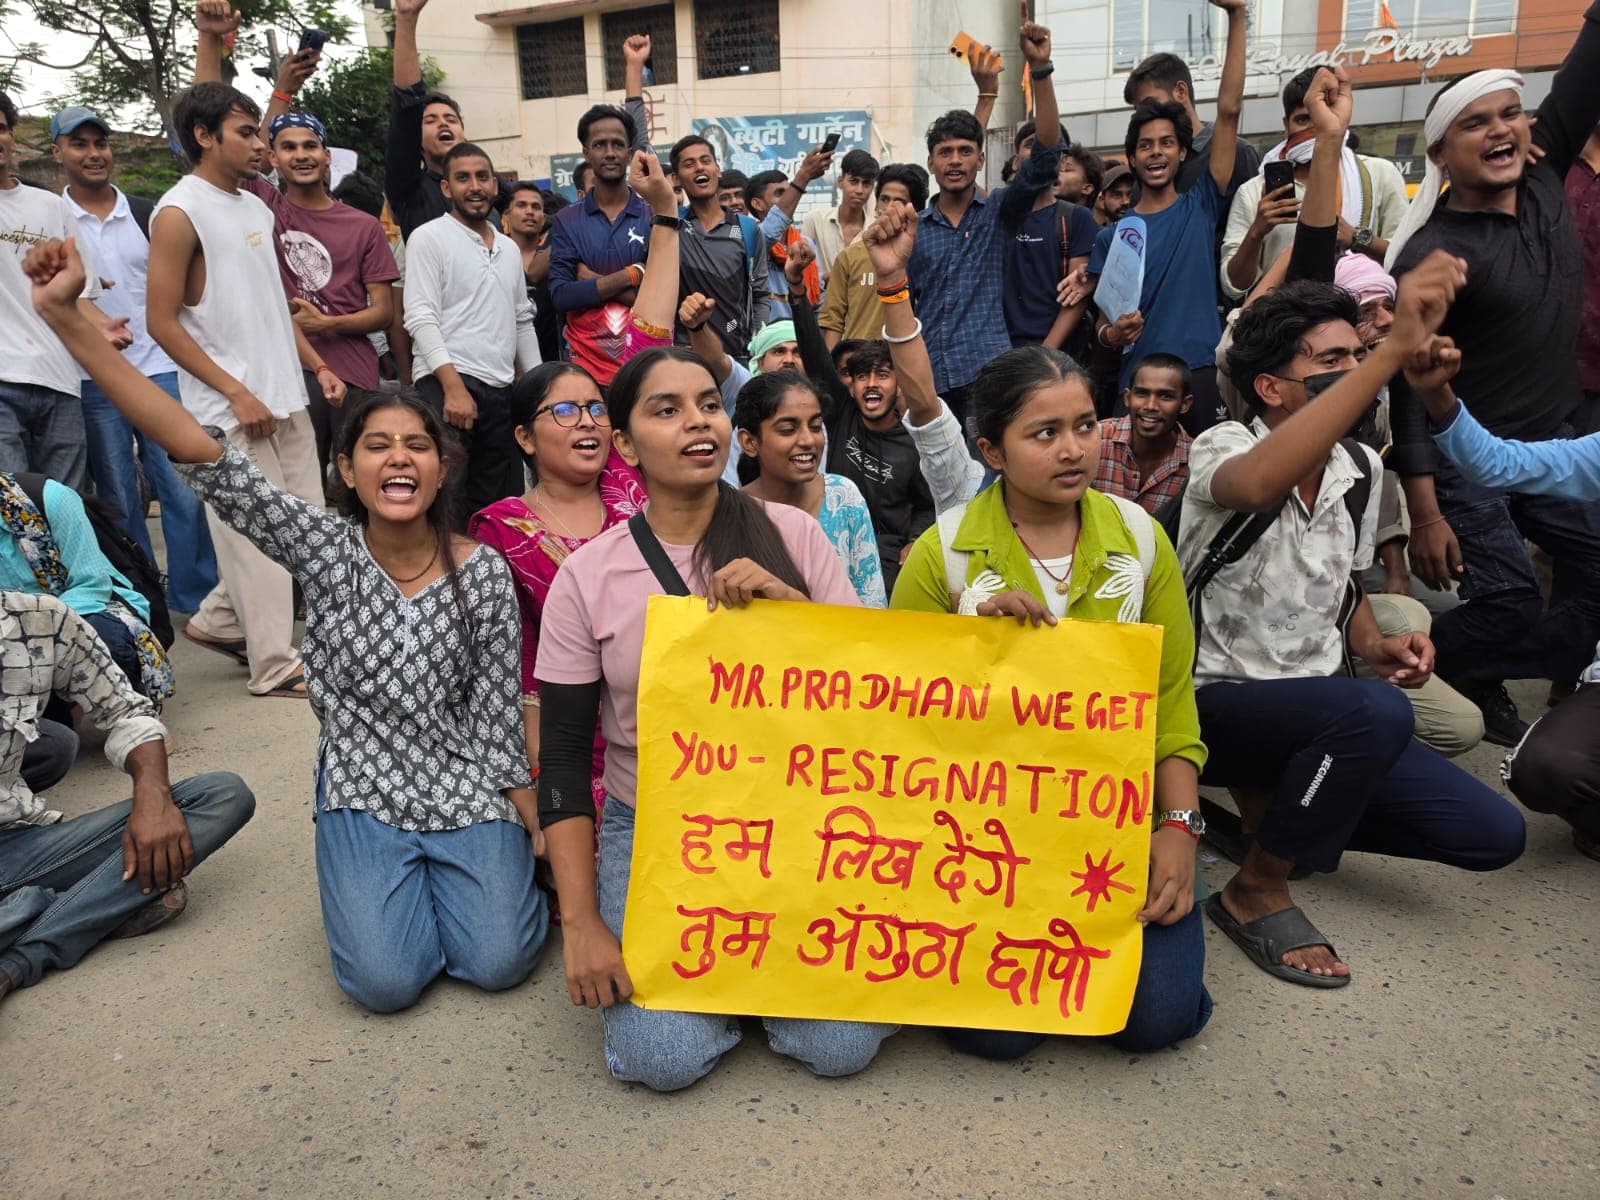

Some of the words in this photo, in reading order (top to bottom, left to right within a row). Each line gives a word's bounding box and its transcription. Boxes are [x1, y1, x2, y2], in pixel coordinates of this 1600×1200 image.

[1361, 28, 1473, 69] Plaza
[781, 666, 991, 721] PRADHAN
[1011, 686, 1076, 731] WE
[1085, 691, 1155, 731] GET
[786, 743, 1151, 830] RESIGNATION
[681, 813, 774, 878] हम
[814, 805, 924, 890] लिख
[934, 810, 1031, 908] देंगे
[672, 904, 777, 979] तुम
[986, 918, 1112, 1018] छापो
